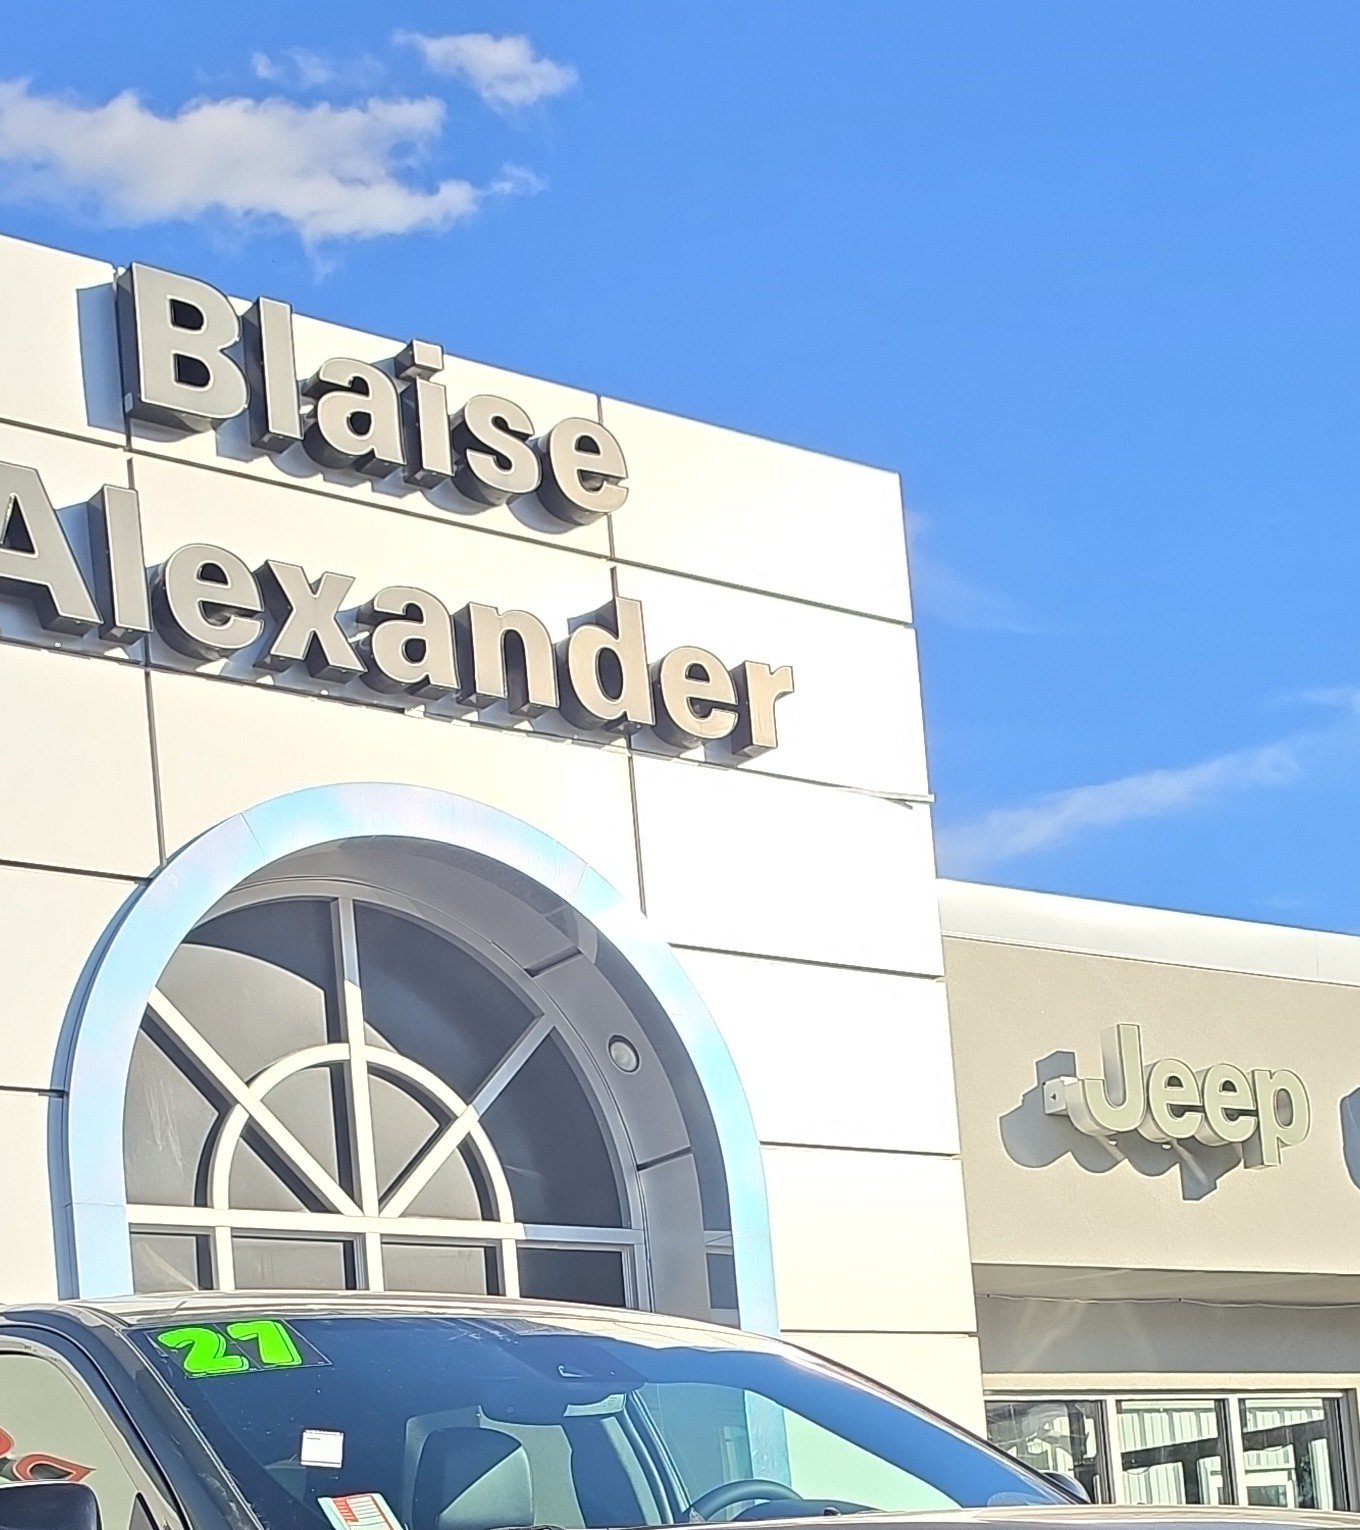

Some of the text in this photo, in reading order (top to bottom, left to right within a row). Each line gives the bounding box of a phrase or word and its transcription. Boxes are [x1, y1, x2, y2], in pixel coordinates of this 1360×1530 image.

[122, 262, 628, 520] Blaise
[1078, 1023, 1311, 1168] Jeep
[157, 1320, 303, 1373] 27
